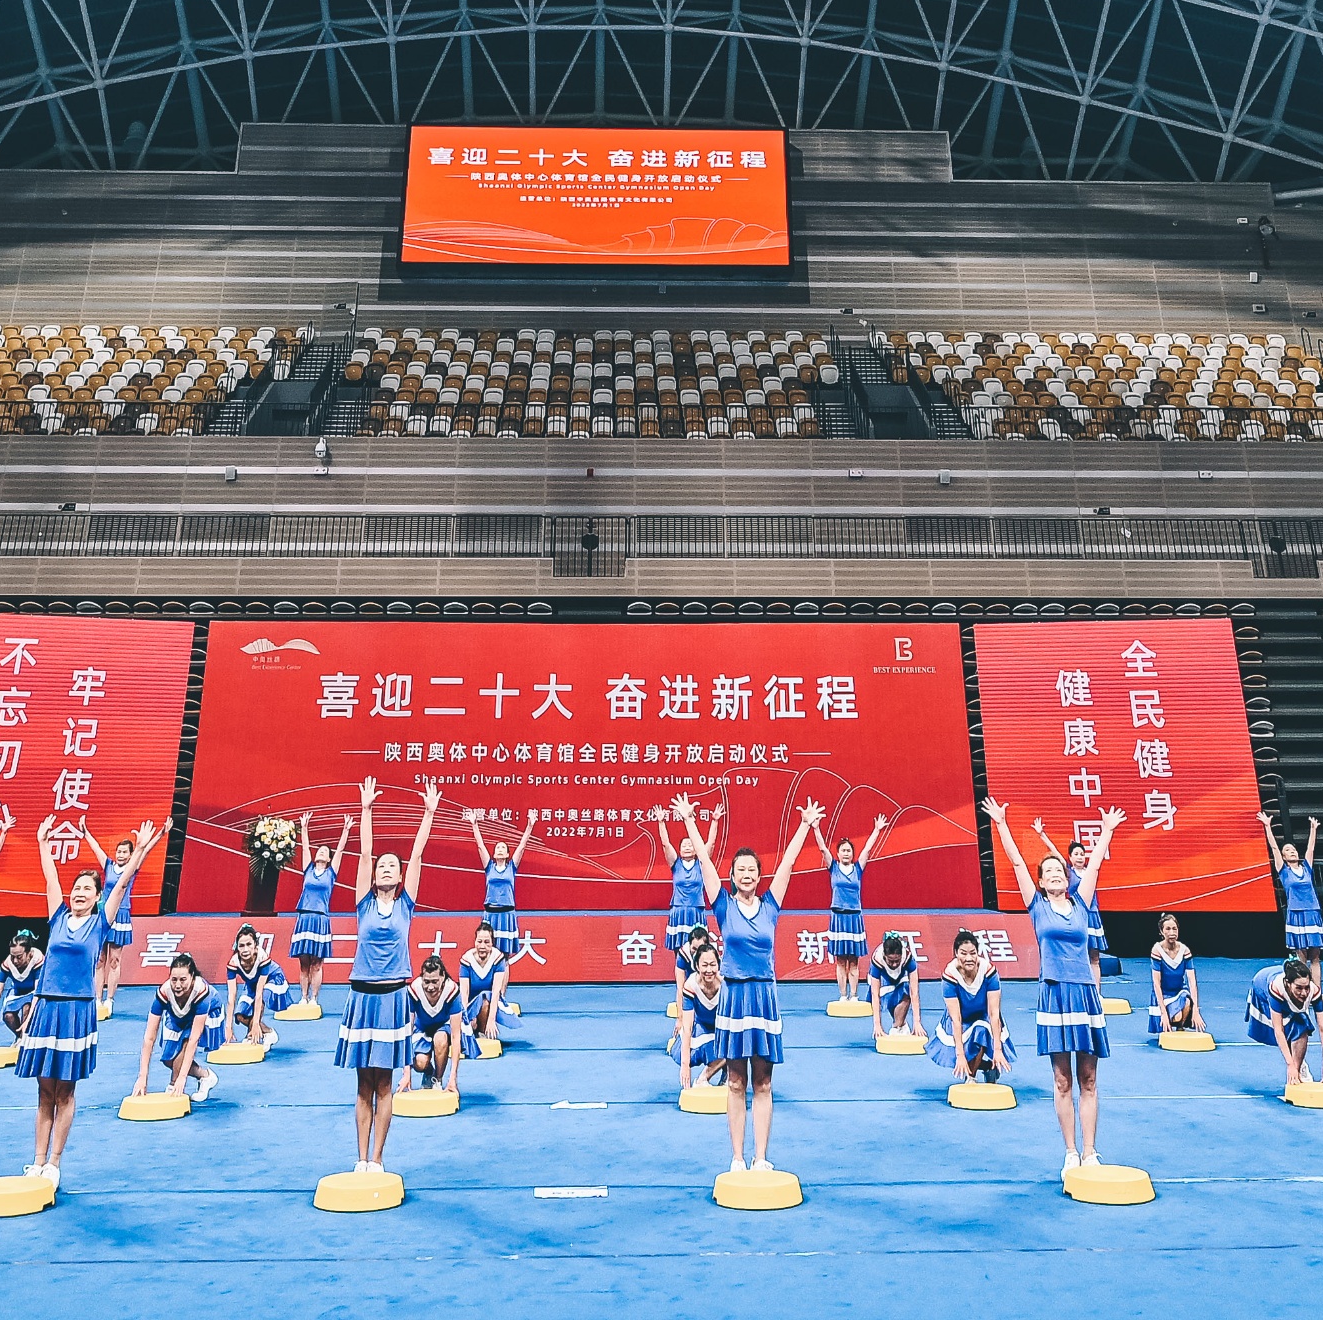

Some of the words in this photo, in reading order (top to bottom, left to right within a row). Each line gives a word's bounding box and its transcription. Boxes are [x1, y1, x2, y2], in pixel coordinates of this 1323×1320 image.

[427, 146, 589, 168] 喜迎二十大
[608, 148, 768, 170] 奋进新征程
[315, 670, 574, 721] 喜迎二十大
[605, 672, 860, 721] 奋进新征程
[1119, 638, 1180, 832] 全民健身
[384, 742, 789, 764] 陕西奥体中心体育馆全民健身开放启动仪式
[47, 666, 108, 865] 牢记使命
[414, 774, 466, 784] Shaanxi
[470, 774, 522, 786] Olympic
[527, 774, 569, 786] Sports
[574, 775, 616, 785] Center
[620, 775, 694, 787] Gymnasium
[699, 775, 731, 787] Open
[736, 775, 759, 787] Day
[546, 826, 624, 838] 2022年7月1日
